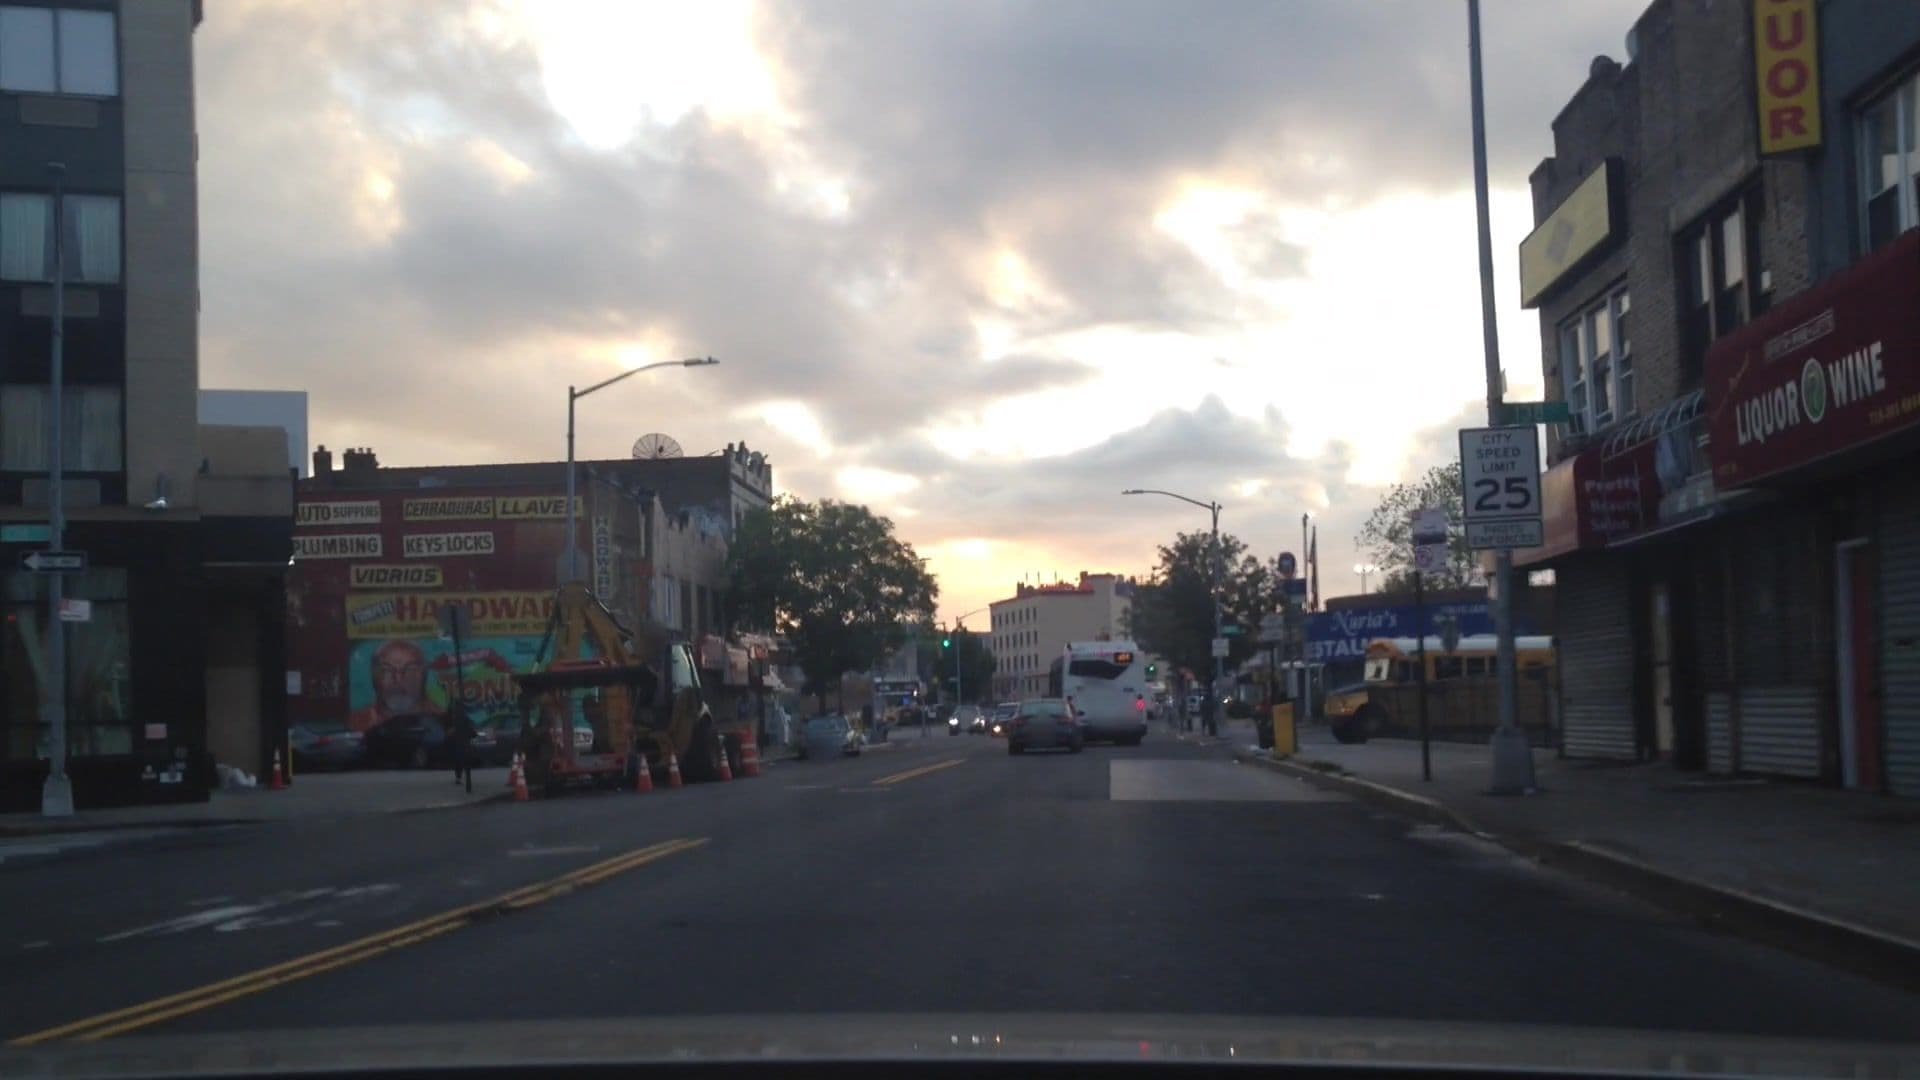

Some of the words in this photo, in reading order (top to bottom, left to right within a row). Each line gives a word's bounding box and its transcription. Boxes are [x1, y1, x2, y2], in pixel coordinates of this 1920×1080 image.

[1766, 0, 1809, 141] UOR
[1735, 379, 1800, 447] LIQUOR
[1827, 340, 1886, 409] WINE
[1481, 433, 1512, 445] CITY
[1476, 447, 1521, 459] SPEED
[1481, 462, 1517, 473] LIMIT
[1474, 477, 1531, 511] 25
[501, 499, 578, 515] LLAVE
[291, 536, 379, 556] PLUMBING
[355, 567, 437, 584] VIDRIOS
